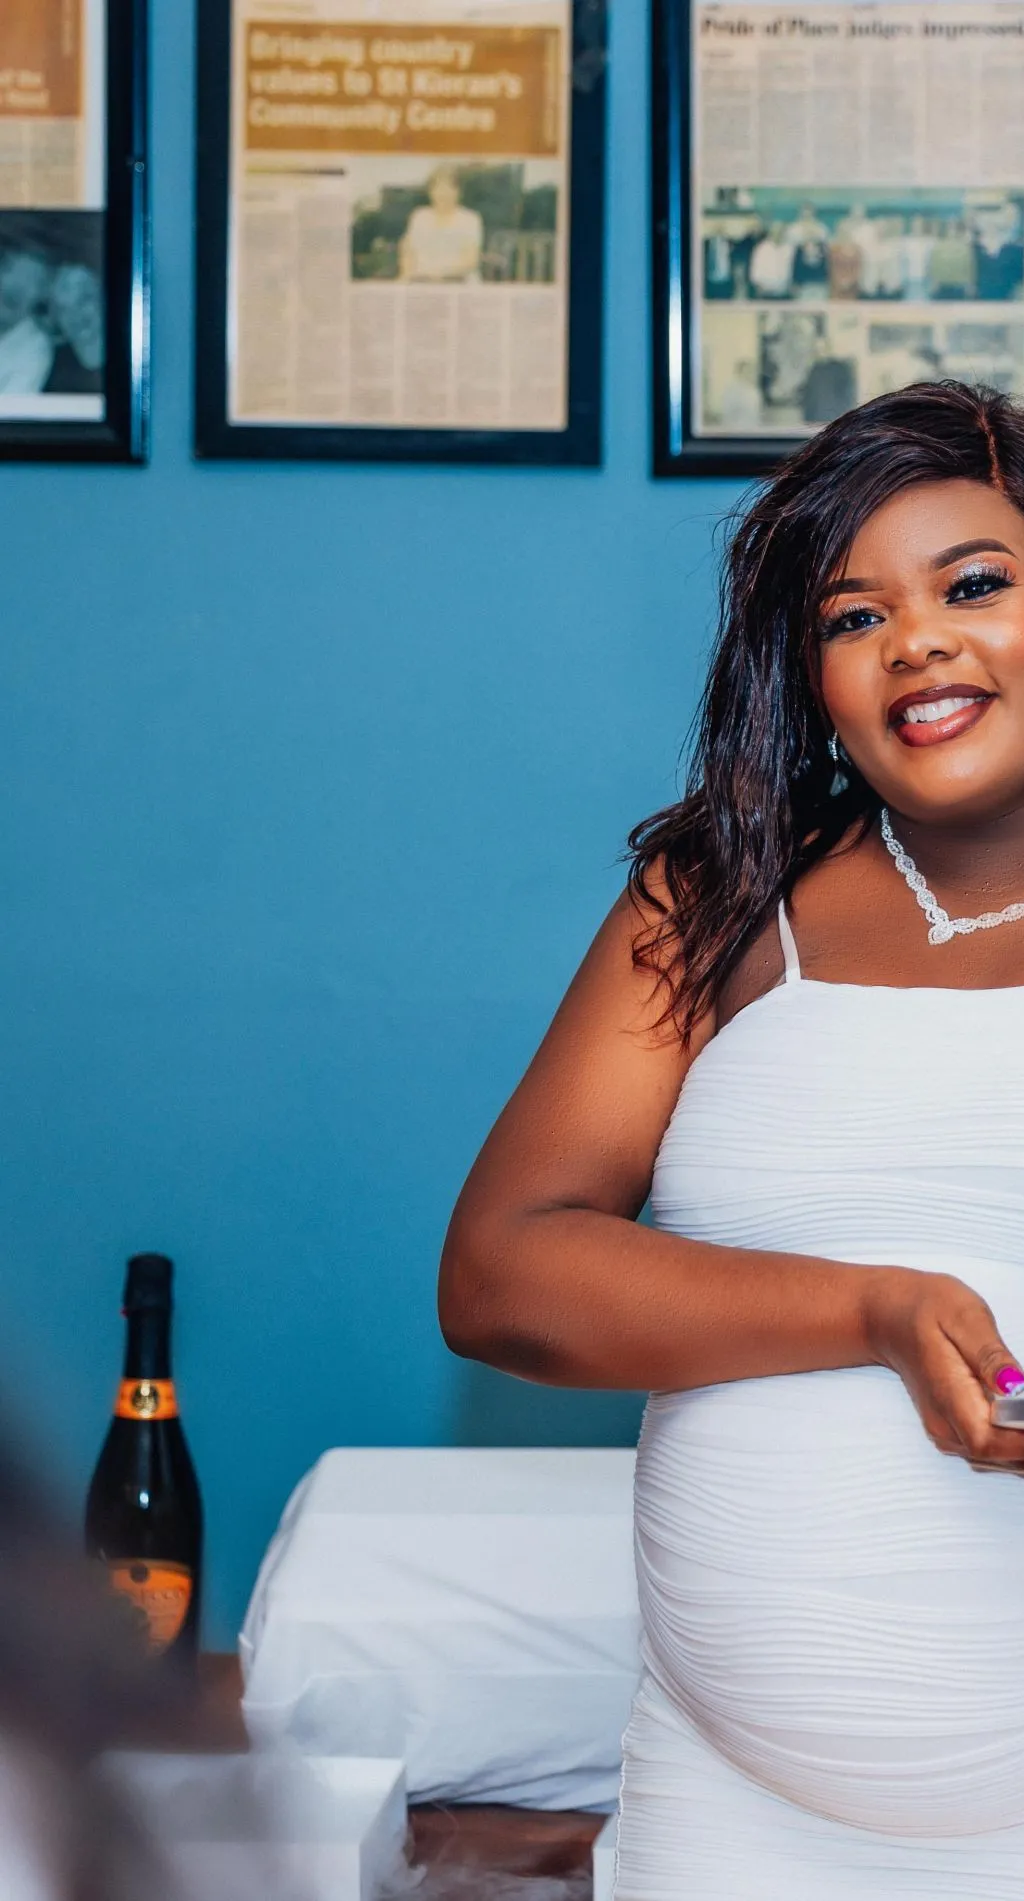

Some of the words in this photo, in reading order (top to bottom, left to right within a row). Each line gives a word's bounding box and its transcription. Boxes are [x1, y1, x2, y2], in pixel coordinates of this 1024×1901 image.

[702, 18, 756, 37] Pride
[764, 17, 784, 37] of
[789, 17, 839, 37] Place
[846, 19, 914, 41] judges
[250, 30, 365, 68] Bringing
[371, 35, 475, 70] country
[250, 65, 338, 96] values
[343, 66, 372, 97] to
[377, 65, 408, 97] St
[411, 66, 522, 100] Kieran's
[250, 97, 401, 136] Community
[405, 99, 497, 132] Centre
